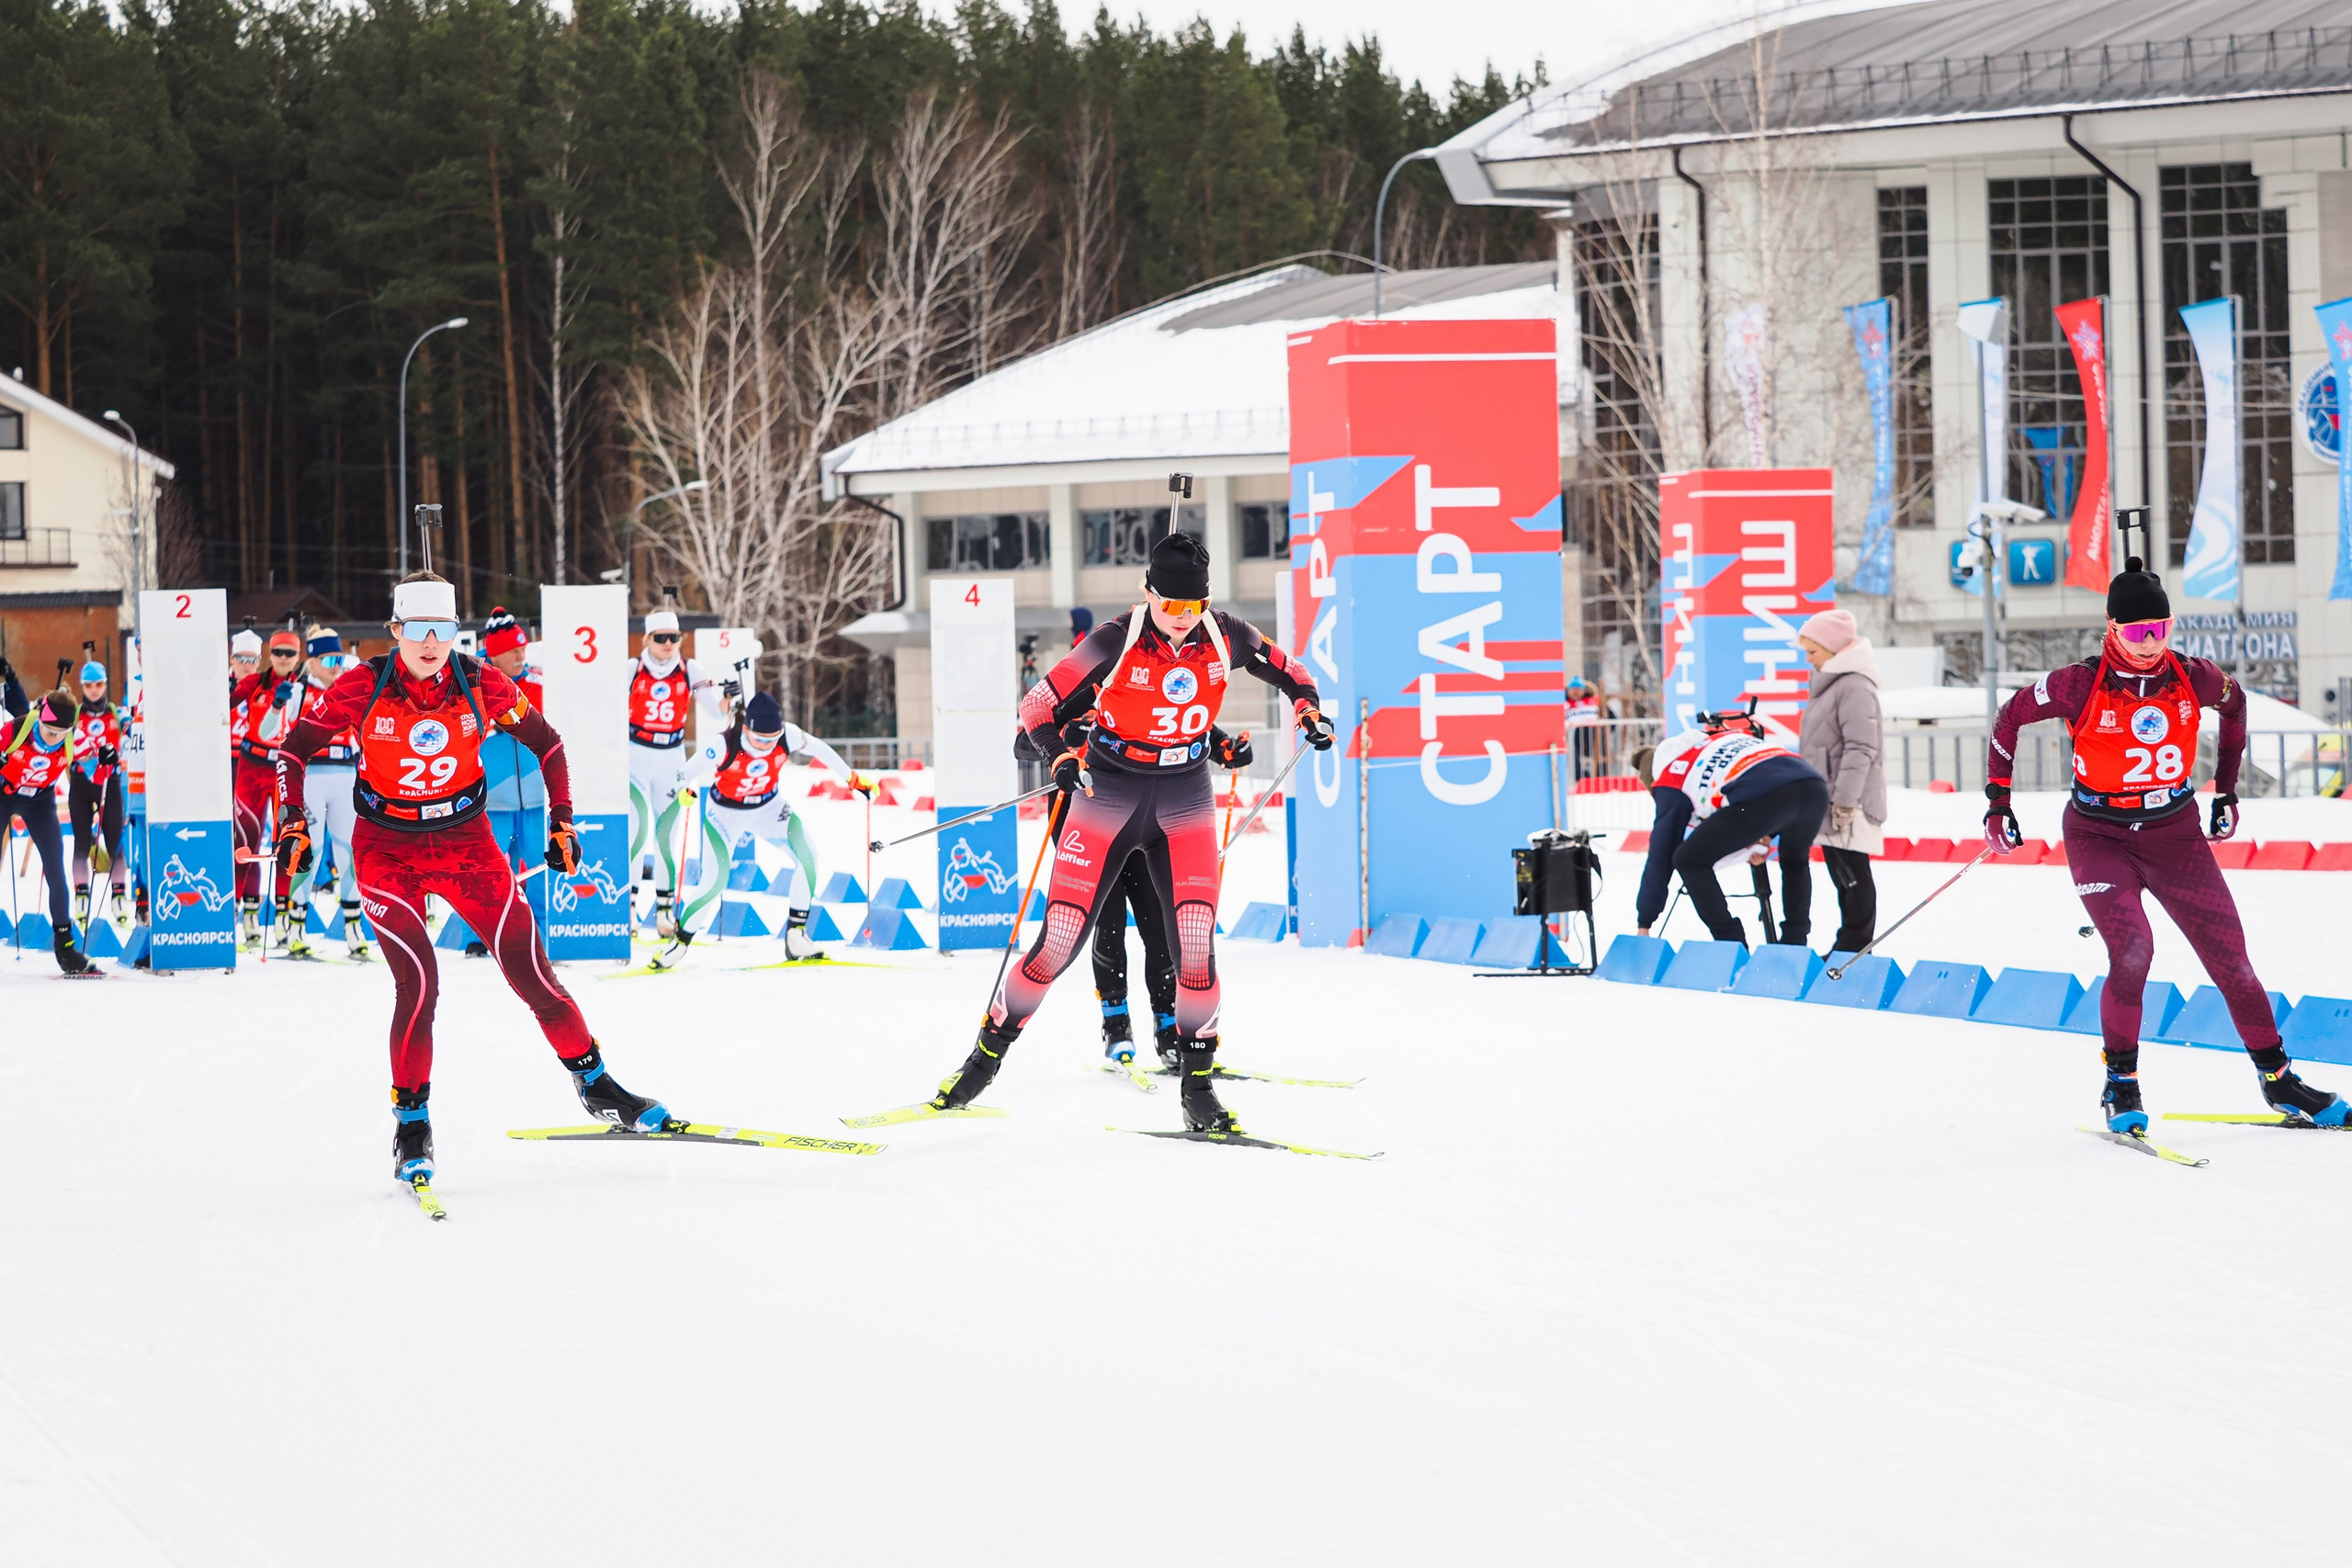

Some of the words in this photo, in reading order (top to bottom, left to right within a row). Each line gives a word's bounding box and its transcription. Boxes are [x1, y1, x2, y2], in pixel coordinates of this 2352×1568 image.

[175, 594, 192, 618] 2
[965, 583, 981, 607] 4
[573, 626, 598, 663] 3
[719, 631, 730, 649] 5
[1414, 464, 1508, 806] СТАРТ
[645, 700, 674, 723] 36
[1149, 705, 1209, 736] 30
[398, 756, 458, 789] 29
[2122, 744, 2184, 783] 28
[1057, 851, 1091, 867] Löffler
[549, 923, 629, 938] КРАСНОЯРСК
[940, 913, 1017, 927] КРАСНОЯРСК
[153, 931, 234, 947] КРАСНОЯРСК
[577, 1055, 593, 1066] 179
[783, 1136, 859, 1152] FISCHER
